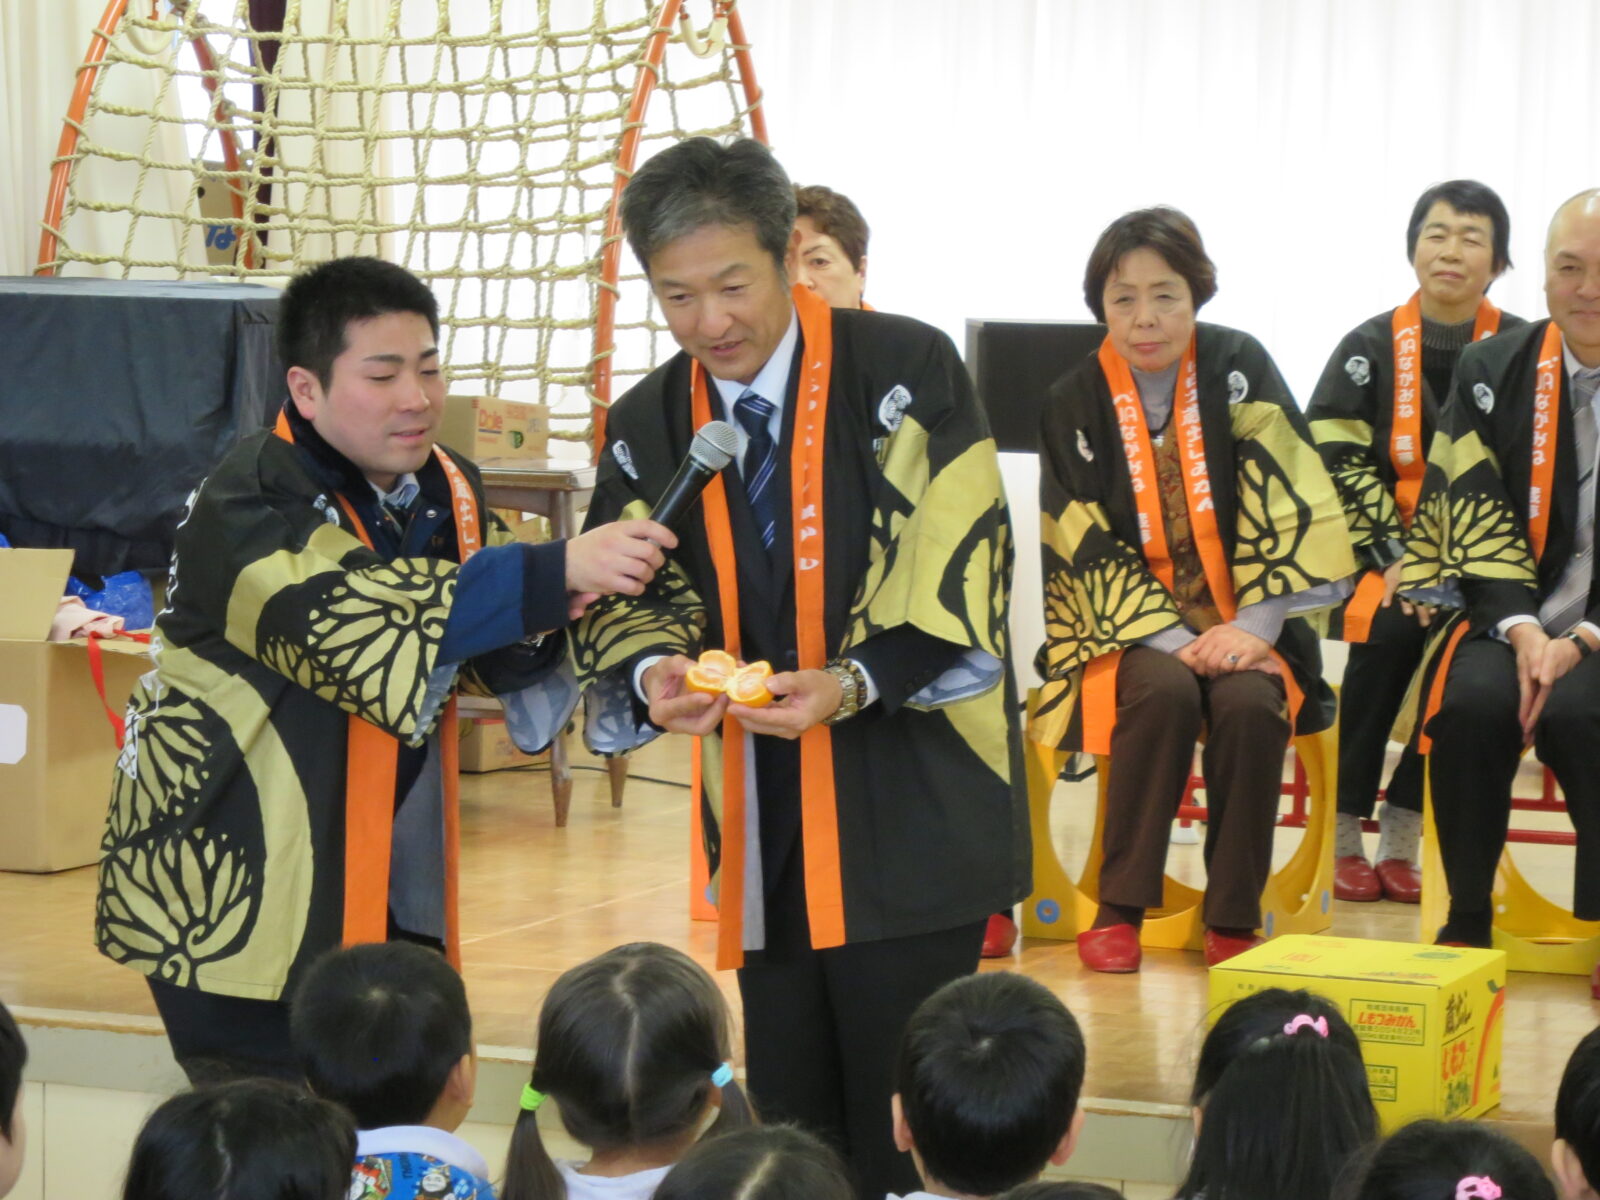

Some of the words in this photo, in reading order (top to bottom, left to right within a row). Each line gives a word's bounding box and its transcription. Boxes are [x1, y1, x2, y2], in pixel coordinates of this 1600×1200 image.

[1357, 1012, 1416, 1028] しもつみかん
